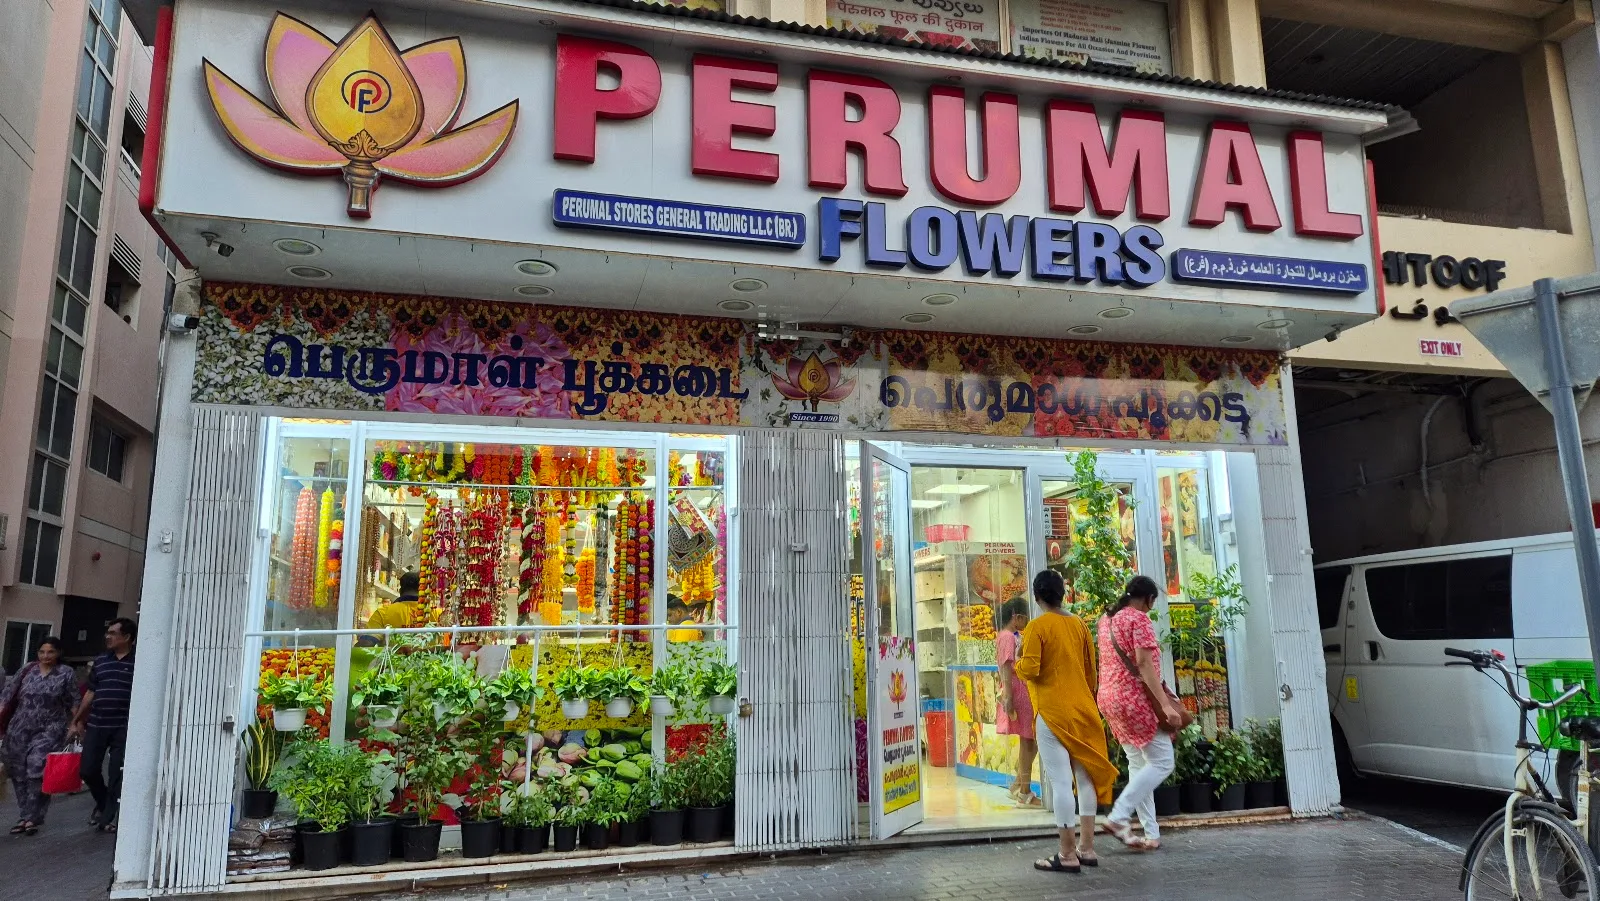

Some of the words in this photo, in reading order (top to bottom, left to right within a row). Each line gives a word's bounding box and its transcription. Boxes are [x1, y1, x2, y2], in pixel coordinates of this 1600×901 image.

[890, 10, 918, 24] फूल
[922, 13, 941, 27] की
[944, 18, 985, 33] दुकान
[1022, 26, 1053, 37] Importers
[1054, 30, 1063, 38] Of
[1019, 35, 1040, 44] Indian
[1065, 41, 1076, 49] For
[1116, 48, 1129, 56] And
[553, 33, 1363, 240] PERUMAL
[562, 196, 612, 222] PERUMAL
[614, 202, 654, 225] STORES
[656, 206, 703, 230] GENERAL
[704, 210, 748, 235] TRADING
[750, 215, 773, 236] L.L.C
[774, 215, 798, 241] (BR.)
[818, 196, 1166, 289] FLOWERS
[1277, 263, 1306, 279] للتجارة
[1338, 270, 1361, 284] مخزن
[1420, 340, 1439, 354] EXIT
[1441, 341, 1462, 356] ONLY
[263, 333, 545, 394] பெருமாள்
[562, 340, 750, 416] பூக்கடை
[791, 413, 817, 421] Since
